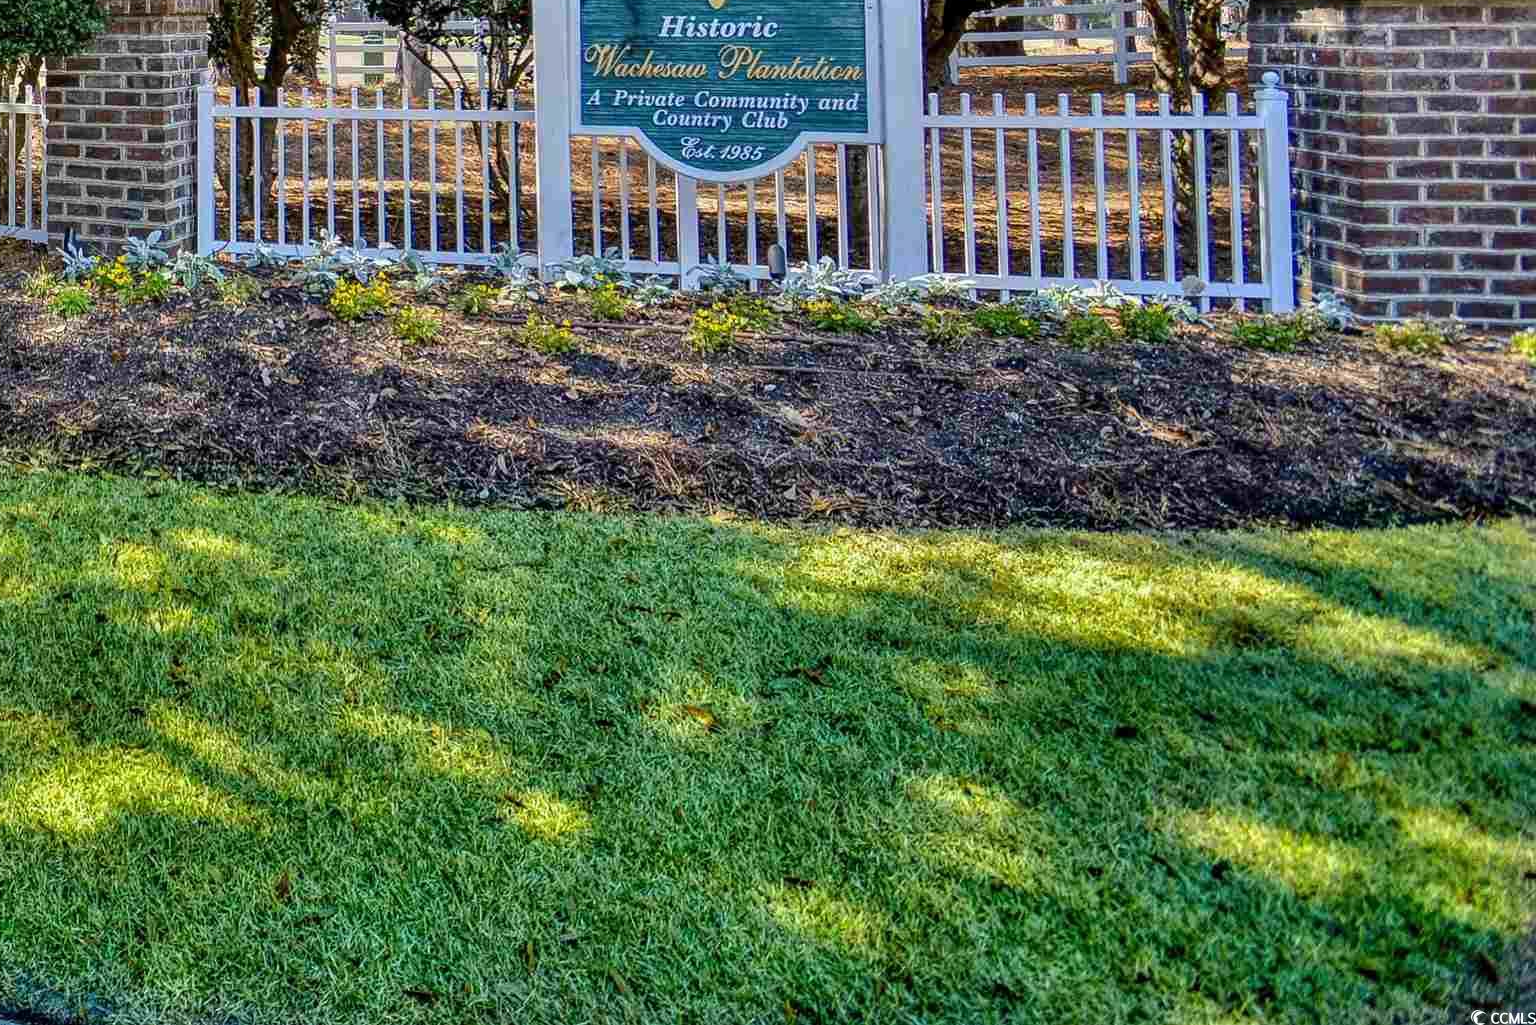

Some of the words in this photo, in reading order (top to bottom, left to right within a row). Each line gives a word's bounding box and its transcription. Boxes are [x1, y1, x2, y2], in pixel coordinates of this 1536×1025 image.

[658, 16, 779, 38] Historic
[584, 44, 708, 78] Wachesaw
[718, 43, 864, 80] Plantation
[585, 89, 601, 106] A
[612, 89, 685, 107] Private
[694, 90, 809, 115] Community
[817, 93, 860, 111] and
[652, 109, 732, 132] Country
[742, 111, 789, 129] Club
[680, 136, 715, 159] Est.
[719, 144, 766, 161] 1985
